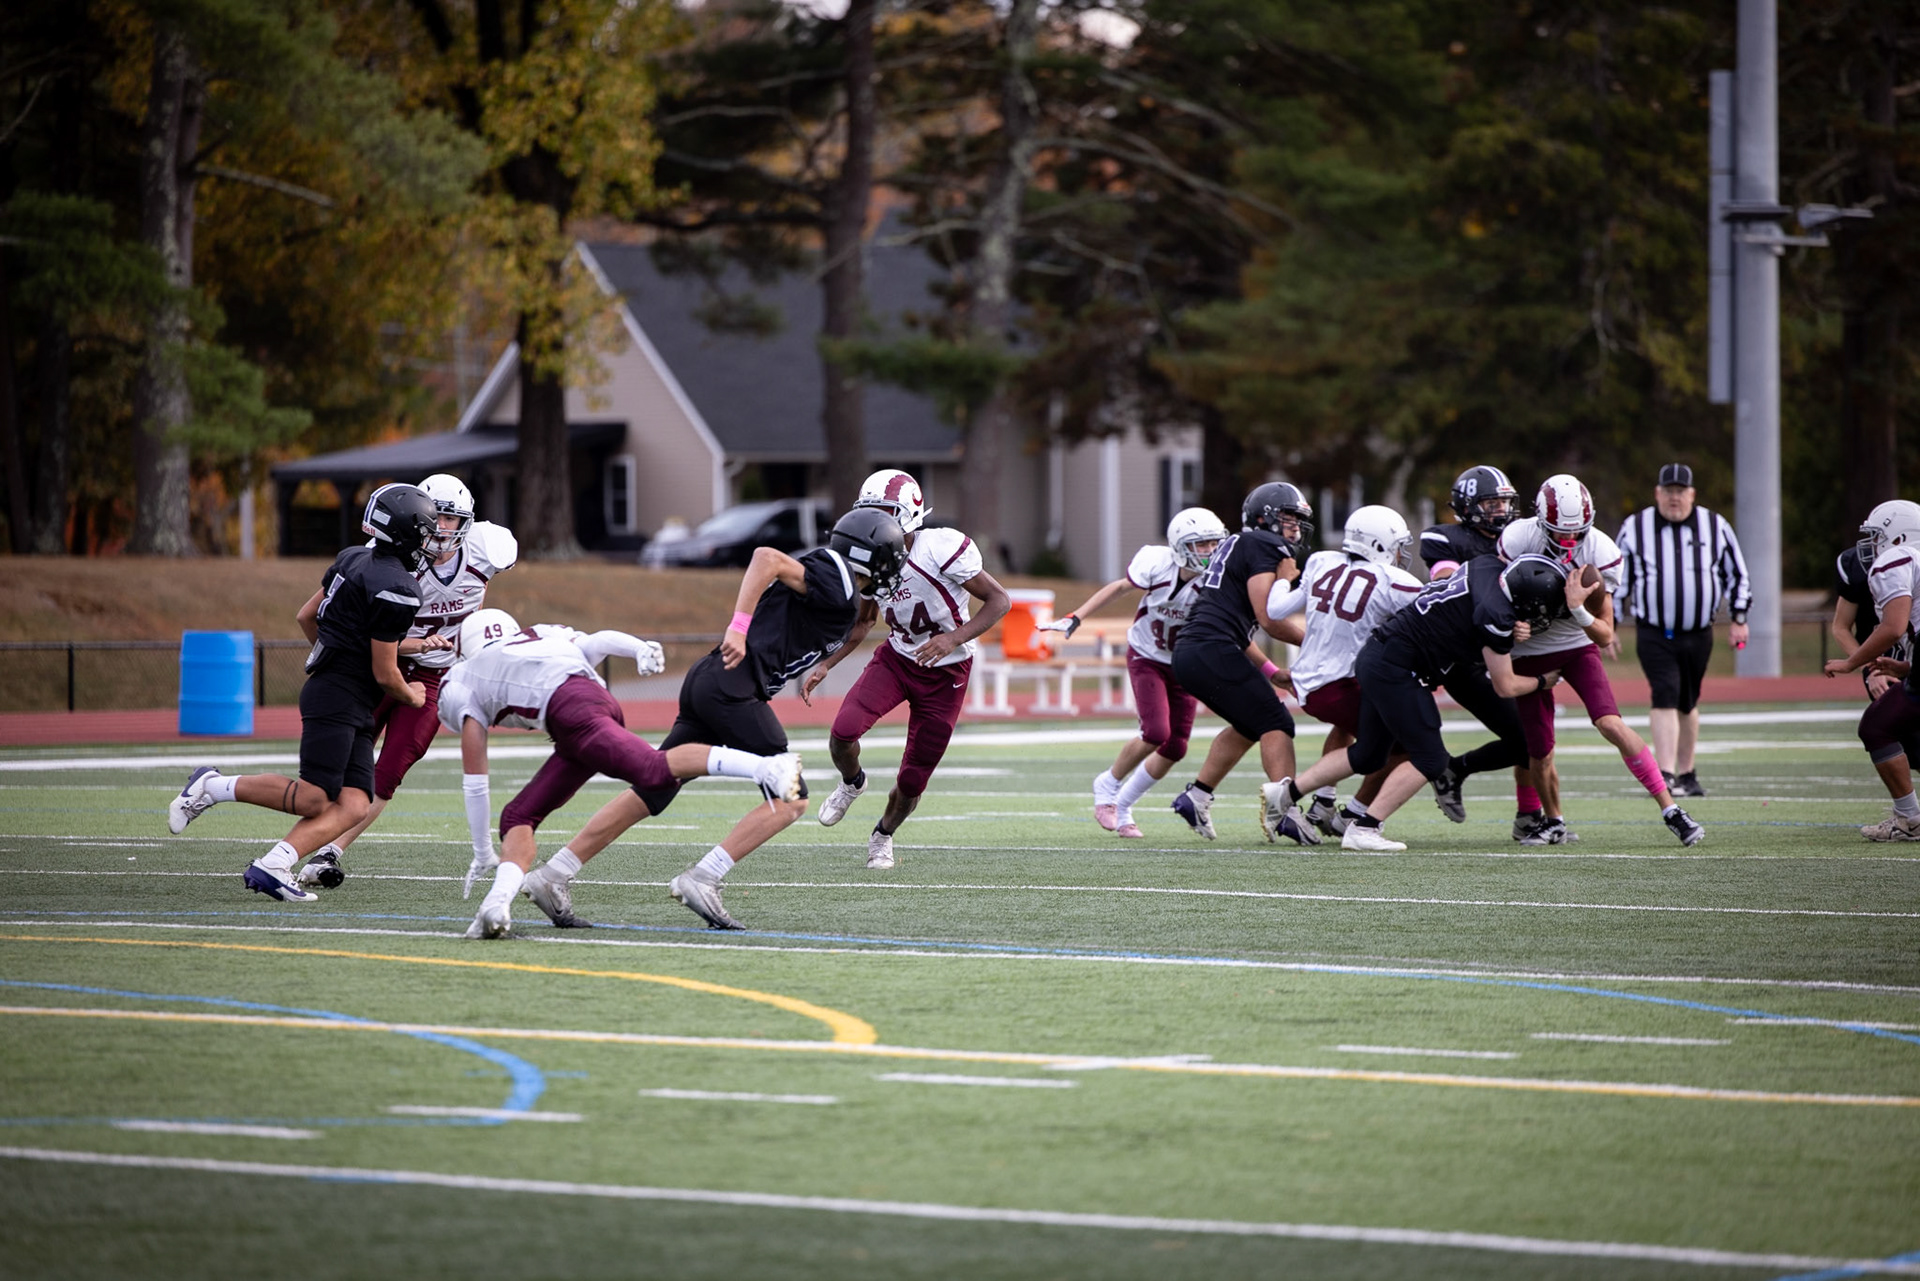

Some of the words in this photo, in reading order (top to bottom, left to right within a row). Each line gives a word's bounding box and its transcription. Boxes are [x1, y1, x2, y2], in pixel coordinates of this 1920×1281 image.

[1458, 479, 1478, 498] 78
[1203, 534, 1240, 589] 4
[891, 588, 912, 603] AMS
[1311, 563, 1378, 622] 40
[430, 599, 464, 614] RAMS
[484, 623, 503, 640] 49
[885, 601, 945, 645] 44
